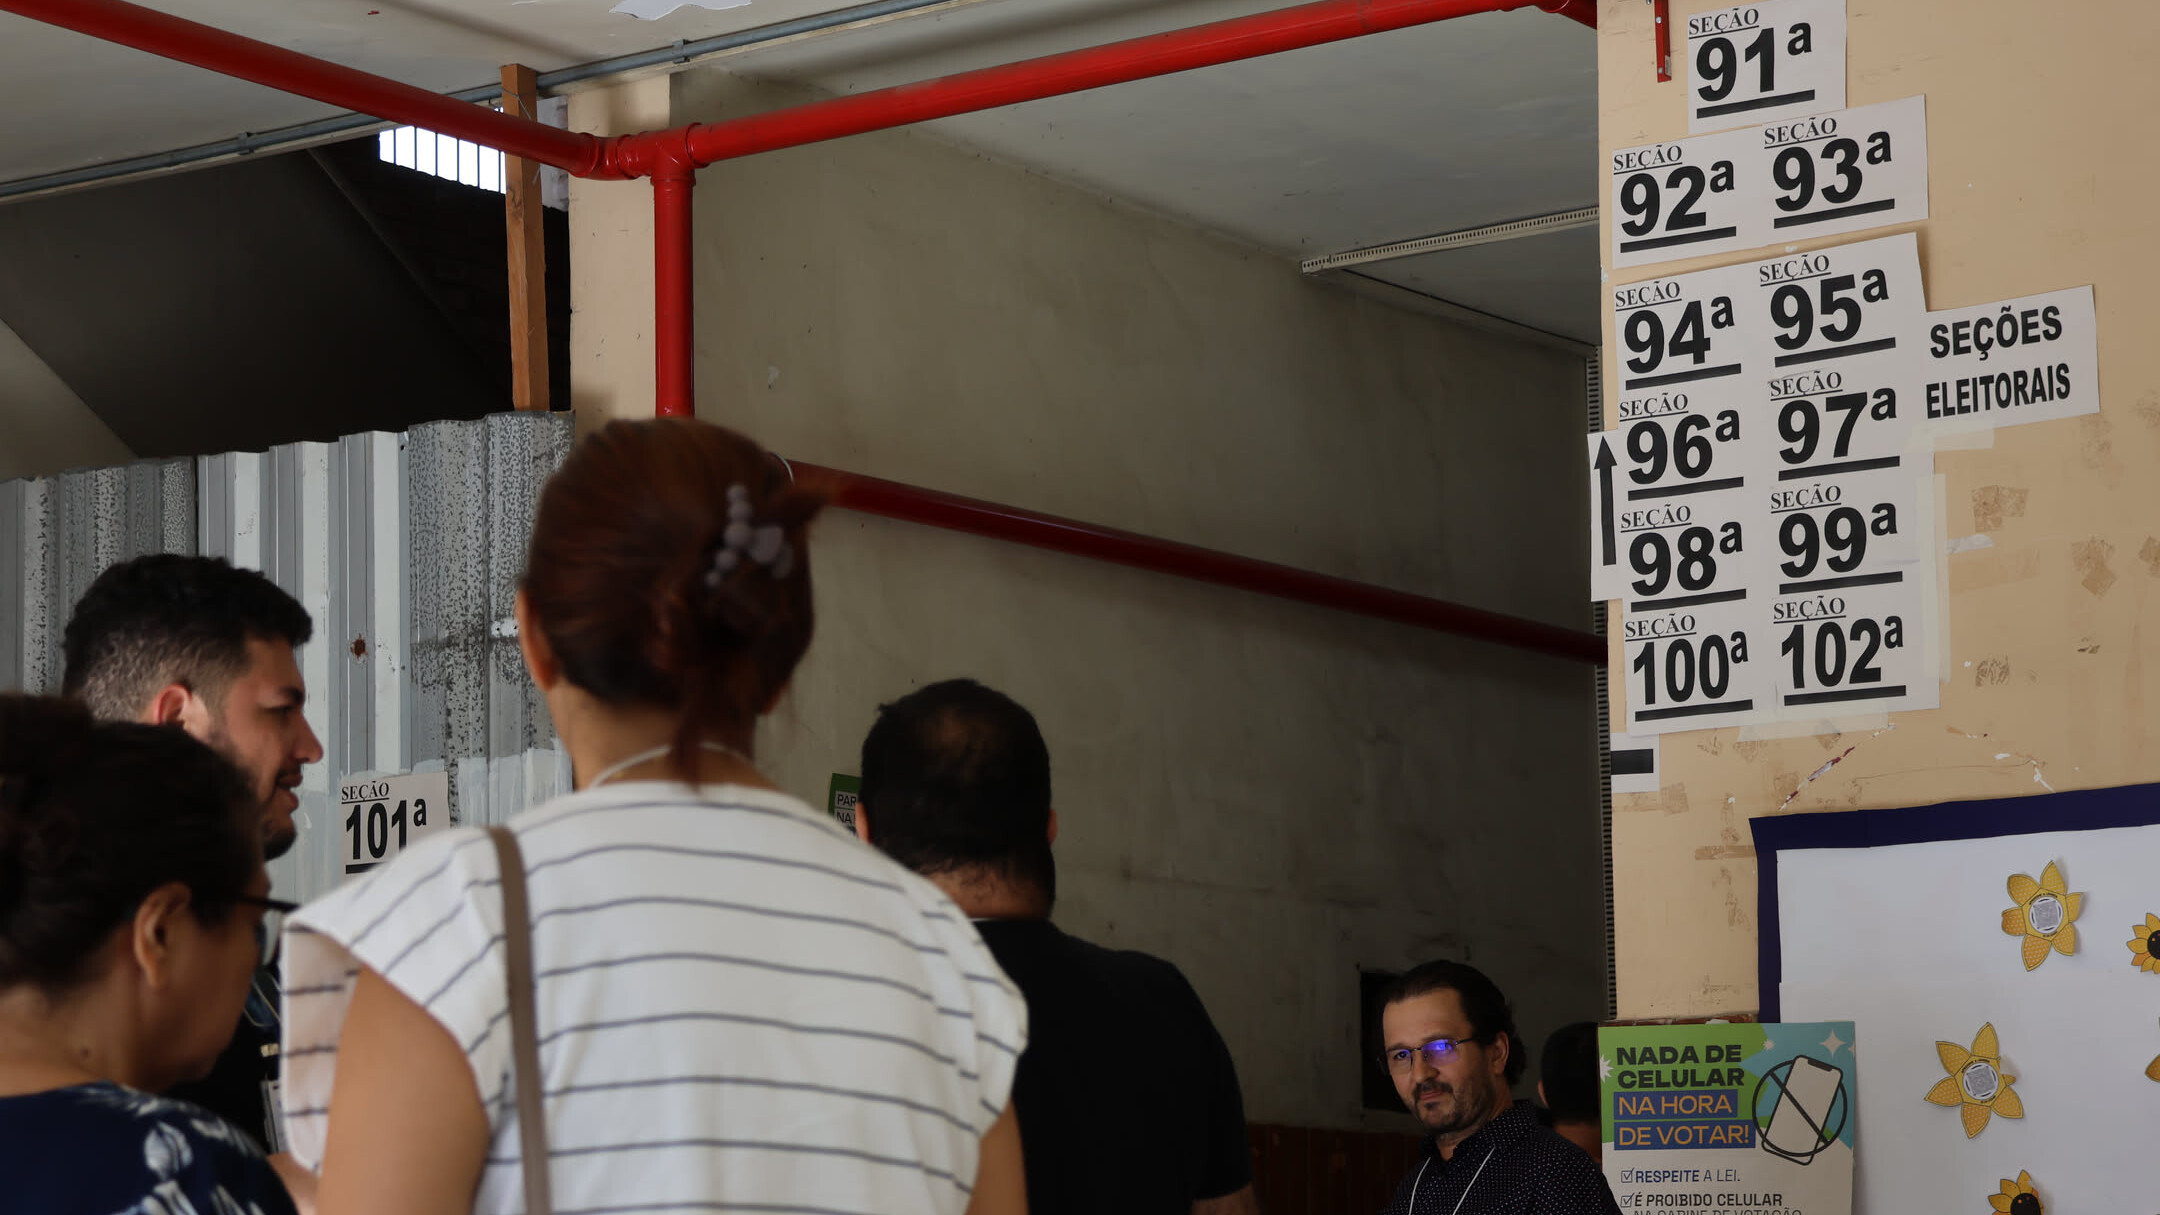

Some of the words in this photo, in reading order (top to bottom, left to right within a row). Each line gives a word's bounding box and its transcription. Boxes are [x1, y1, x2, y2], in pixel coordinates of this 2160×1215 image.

[1689, 7, 1759, 36] SEÇÃO
[1764, 117, 1837, 146] SEÇÃO
[1613, 145, 1683, 172] SEÇÃO
[1760, 254, 1830, 283] SEÇÃO
[1615, 281, 1681, 308] SEÇÃO
[1930, 304, 2063, 360] SEÇÕES
[1770, 372, 1843, 398] SEÇÃO
[1926, 363, 2071, 419] ELEITORAIS
[1619, 393, 1689, 418] SEÇÃO
[1771, 485, 1842, 510] SEÇÃO
[1620, 505, 1691, 529] SEÇÃO
[1773, 595, 1845, 621] SEÇÃO
[1625, 614, 1696, 638] SEÇÃO
[341, 780, 390, 801] SEÇÃO
[837, 794, 857, 807] PAR
[1617, 1046, 1700, 1066] NADA
[1706, 1044, 1742, 1063] DE
[1617, 1068, 1744, 1089] CELULAR
[1618, 1096, 1656, 1115] NA
[1661, 1094, 1733, 1114] HORA
[1619, 1126, 1651, 1146] DE
[1656, 1124, 1749, 1145] VOTAR!
[1635, 1170, 1700, 1183] RESPEITE
[1703, 1169, 1712, 1182] A
[1717, 1169, 1741, 1182] LEI.
[1634, 1191, 1643, 1207] É
[1646, 1194, 1712, 1207] PROIBIDO
[1717, 1193, 1783, 1206] CELULAR
